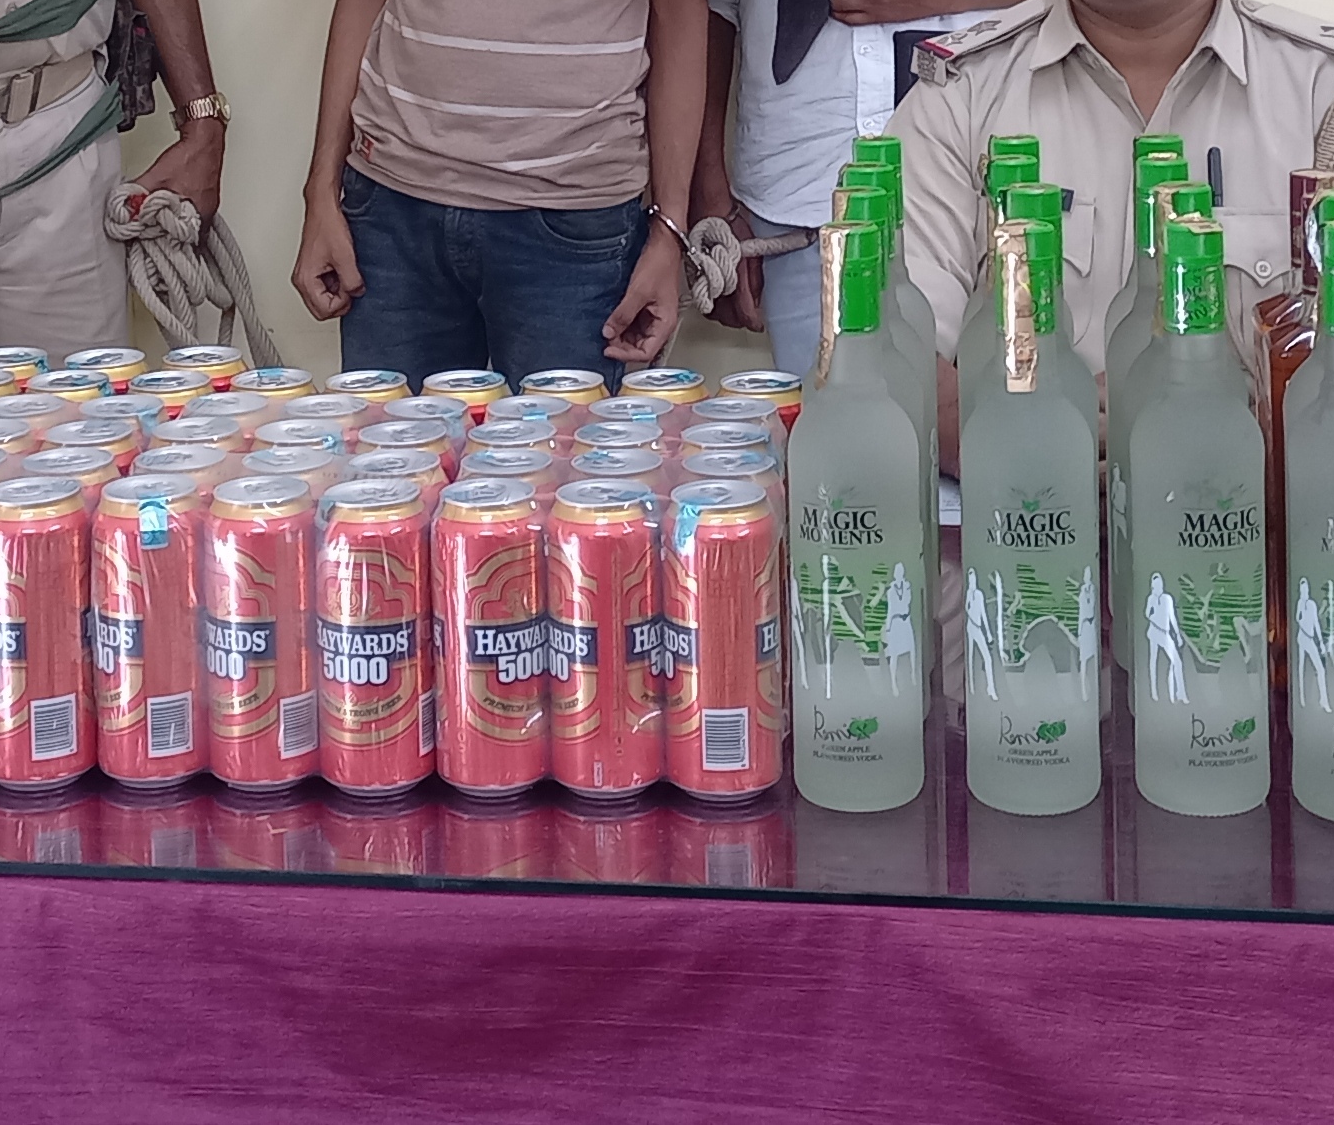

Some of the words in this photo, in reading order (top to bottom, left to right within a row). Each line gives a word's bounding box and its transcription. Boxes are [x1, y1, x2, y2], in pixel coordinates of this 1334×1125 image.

[802, 505, 878, 530] MAGIC
[995, 509, 1071, 532] MAGIC
[1183, 506, 1258, 533] MAGIC
[799, 525, 884, 546] MOMENTS
[987, 527, 1076, 548] MOMENTS
[1178, 525, 1261, 548] MOMENTS
[323, 655, 389, 684] 5000
